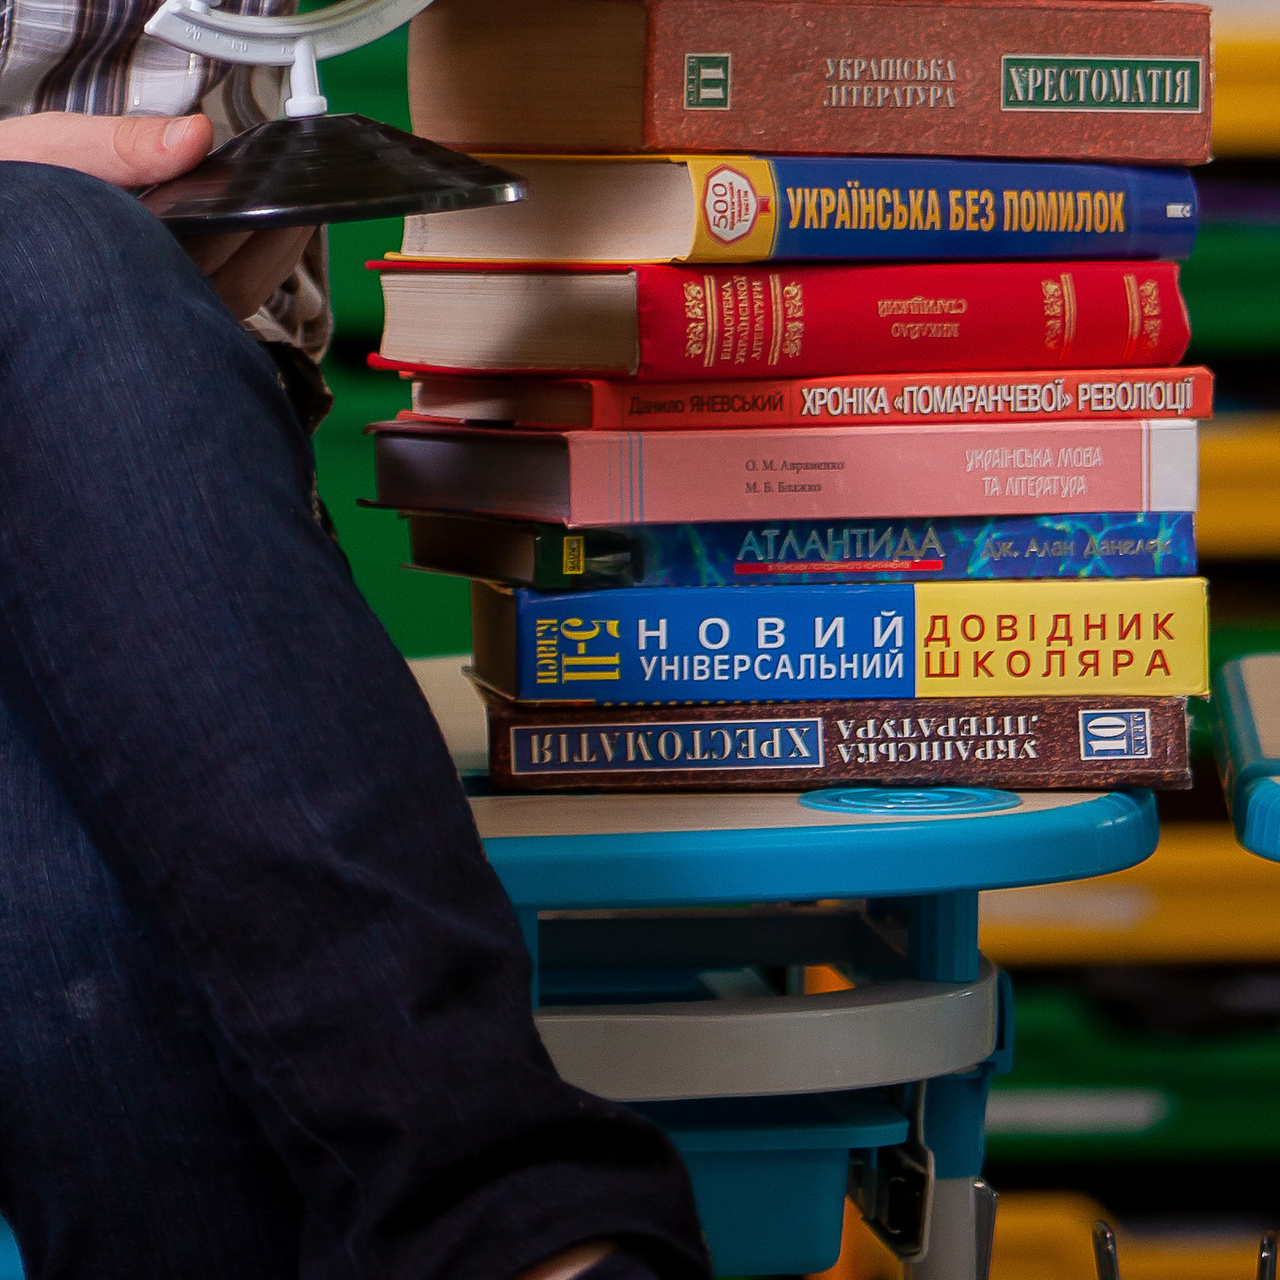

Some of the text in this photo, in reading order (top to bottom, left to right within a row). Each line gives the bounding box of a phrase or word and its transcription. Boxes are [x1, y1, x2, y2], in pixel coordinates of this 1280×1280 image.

[823, 85, 957, 108] ЛІТЕРАТУРА
[1008, 67, 1192, 104] ХРЕСТОМАТІЯ
[712, 182, 729, 230] 500
[786, 180, 1127, 233] УКРАЇНСЬКА БЕЗ ПОМИЛОК
[720, 281, 733, 361] БІБЛІОТЕКА
[733, 275, 747, 365] УКРАЇНСЬКОЇ
[751, 280, 764, 361] ЛІТЕРАТУРИ
[891, 322, 960, 340] МИХАЙЛО
[628, 391, 784, 416] Данило ЯНЕВСЬКИЙ
[801, 376, 1195, 416] ХРОНІКА «ПОМАРАНЧЕВОЇ» РЕВОЛЮЦІЇ
[762, 460, 777, 471] М.
[780, 460, 845, 474] Авраменко
[965, 446, 1104, 472] УКРАЇНСЬКА МОВА
[745, 482, 760, 493] М.
[778, 482, 822, 493] Блажко
[982, 475, 1089, 498] ТА ЛІТЕРАТУРА
[736, 527, 946, 562] АТЛАНТИДА
[981, 539, 1019, 561] Дж.
[1025, 538, 1075, 558] Алан
[638, 610, 904, 650] НОВИЙ
[924, 613, 1175, 648] ДОВІДНИК
[561, 618, 620, 684] 5-11
[639, 648, 904, 682] УНІВЕРСАЛЬНИЙ
[924, 649, 1171, 678] ШКОЛЯРА
[835, 715, 1040, 740] ЛІТЕРАТУРА
[1086, 715, 1129, 755] 10
[530, 726, 812, 765] ХРЕСТОМАТІЯ
